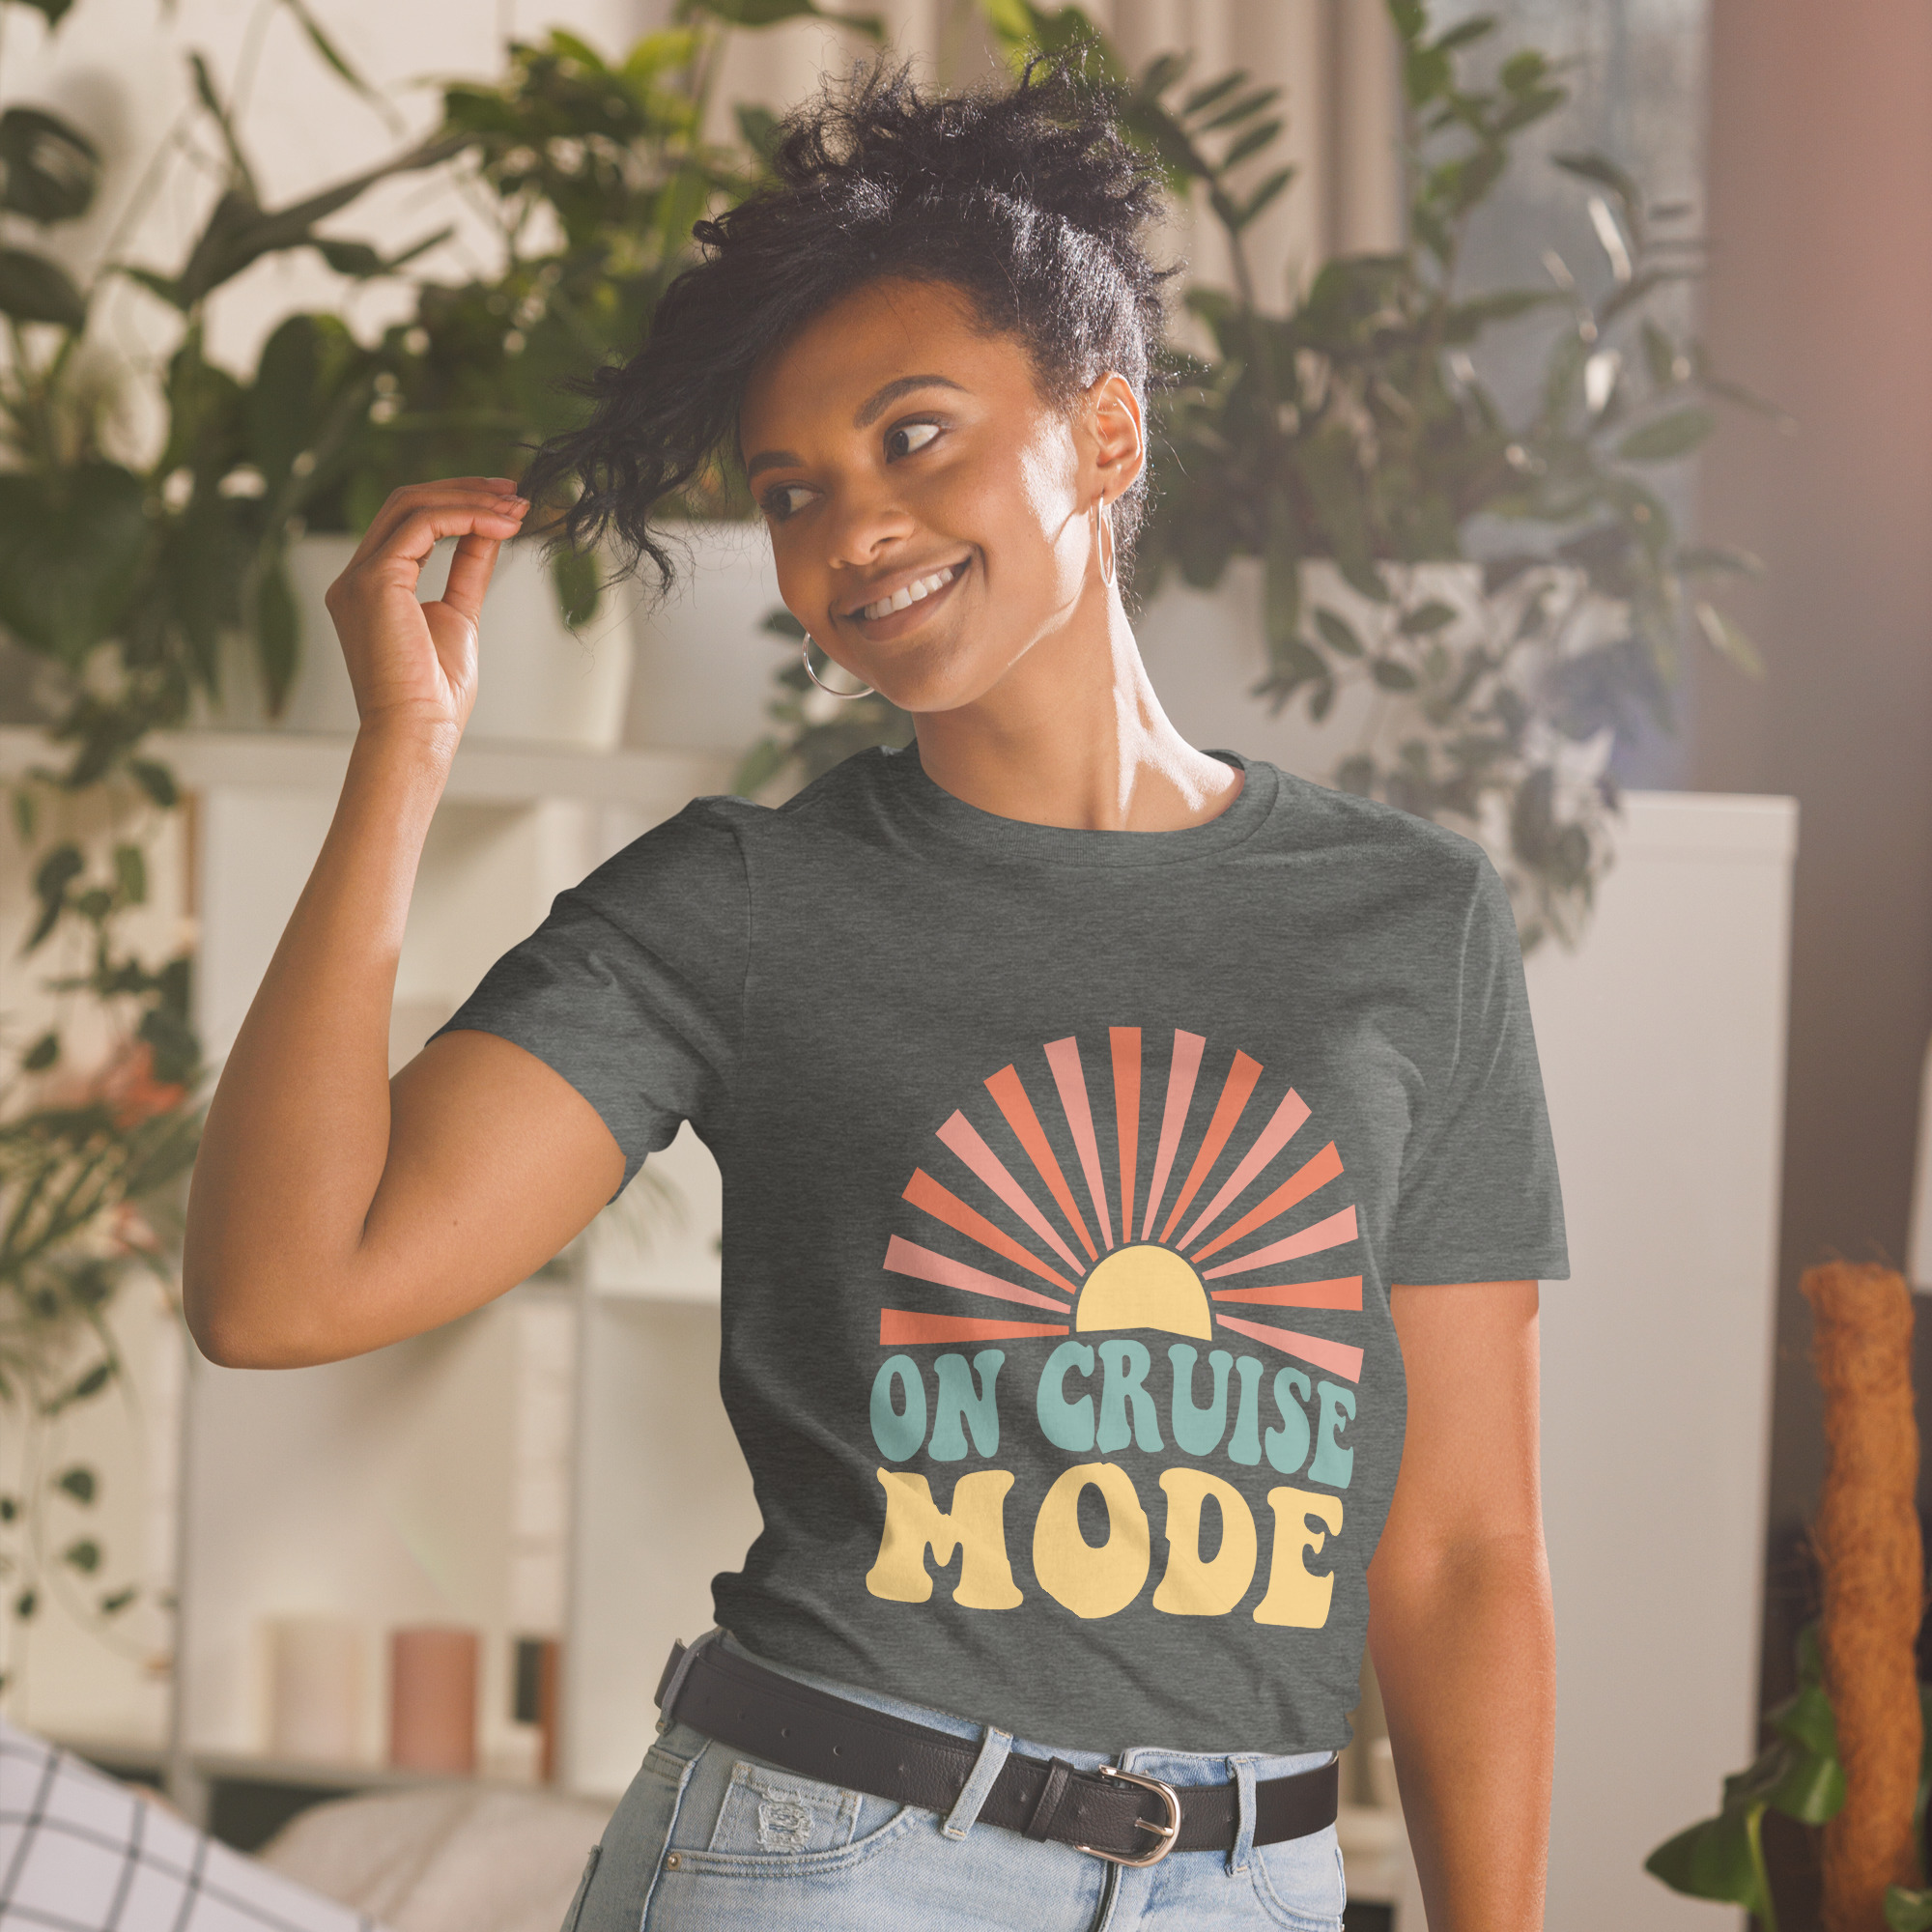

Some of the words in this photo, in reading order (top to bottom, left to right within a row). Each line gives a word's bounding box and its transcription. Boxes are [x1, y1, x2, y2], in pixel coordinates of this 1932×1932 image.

[870, 1349, 1006, 1463] ON
[1037, 1340, 1356, 1489] CRUISE
[866, 1462, 1344, 1629] MODE
